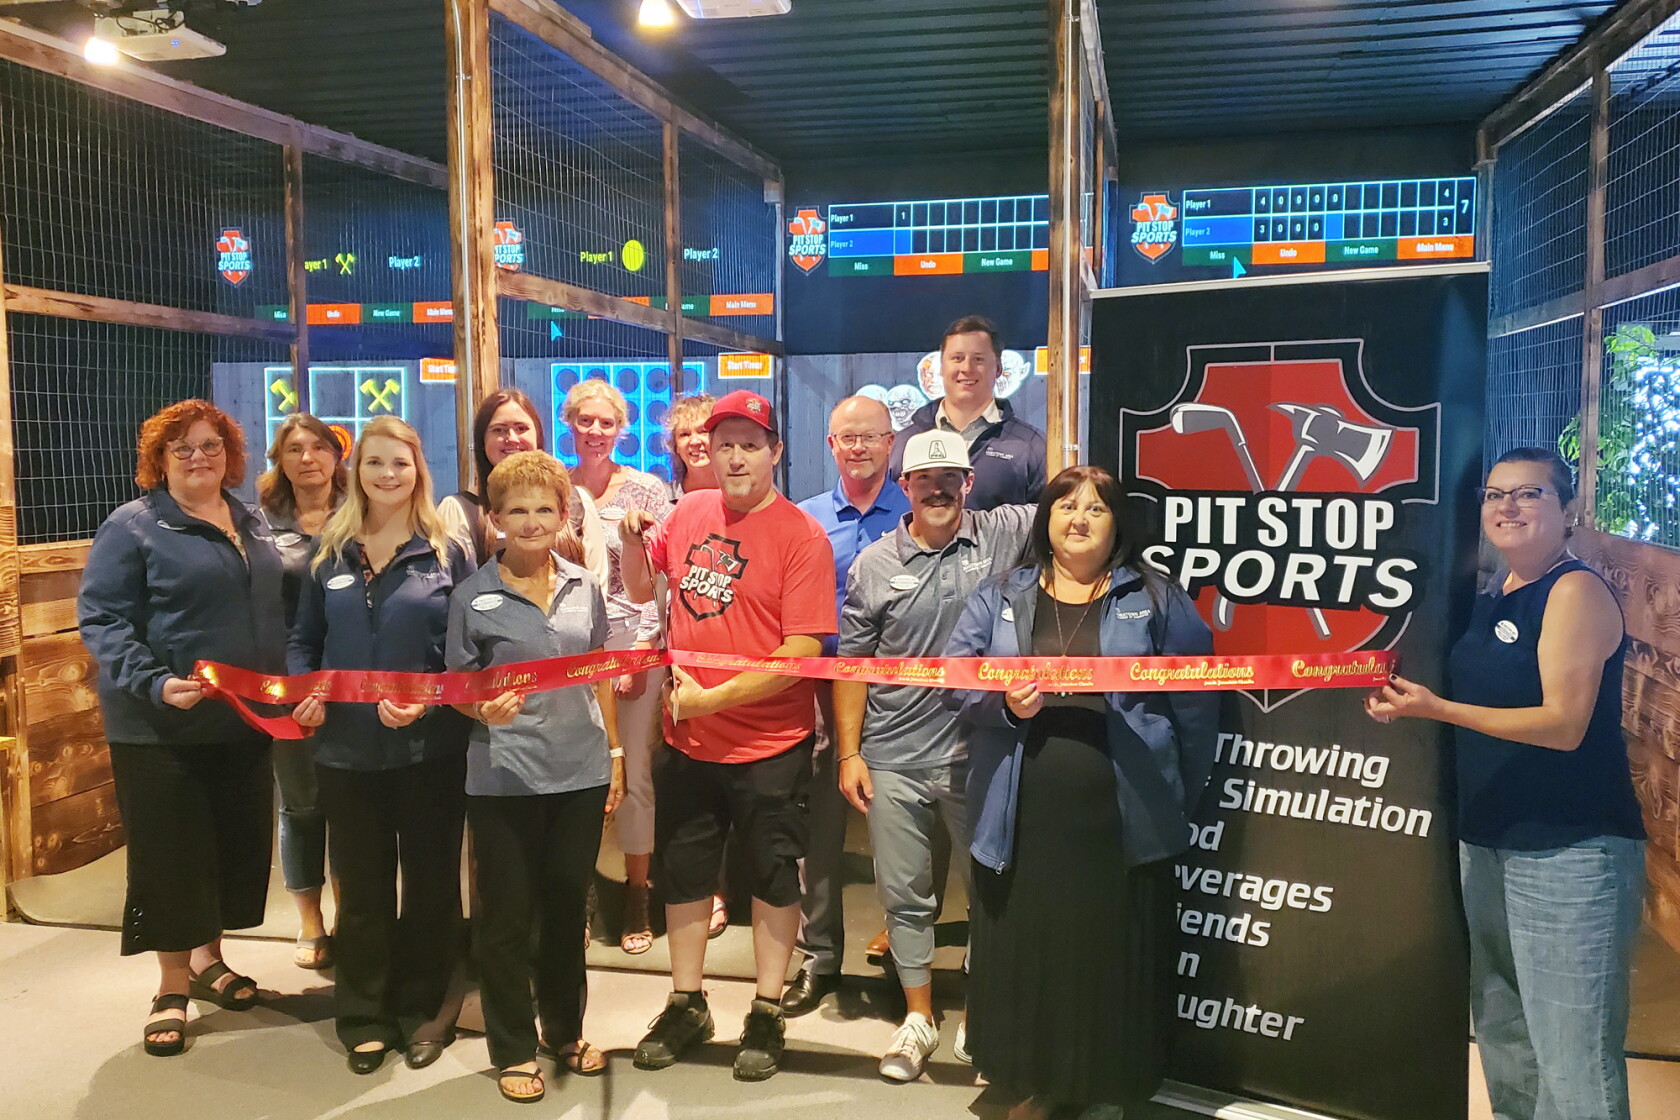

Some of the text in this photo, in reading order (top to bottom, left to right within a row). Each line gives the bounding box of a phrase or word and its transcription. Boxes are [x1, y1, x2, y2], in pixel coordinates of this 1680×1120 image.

[1185, 200, 1207, 210] Player
[1462, 201, 1468, 213] 7
[831, 213, 849, 223] Player
[1136, 220, 1174, 232] PIT STOP
[1131, 231, 1177, 243] SPORTS
[1185, 227, 1206, 238] Player
[793, 234, 823, 245] PIT STOP
[831, 240, 849, 249] Player
[503, 244, 520, 254] STOP
[789, 244, 826, 256] SPORTS
[1280, 248, 1298, 258] Undo
[1344, 245, 1379, 255] New Game
[1416, 242, 1454, 253] Main Menu
[220, 252, 248, 261] PIT STOP
[494, 254, 523, 264] PORTS
[580, 250, 613, 264] Player 1
[684, 248, 718, 262] Player 2
[1210, 251, 1225, 260] Miss
[218, 260, 250, 270] SPORTS
[304, 258, 327, 272] ayer 1
[388, 256, 420, 270] Player 2
[854, 262, 868, 270] Miss
[920, 260, 936, 268] Undo
[982, 257, 1012, 266] New Game
[1164, 496, 1394, 551] PIT STOP
[689, 565, 732, 588] PIT STOP
[1141, 545, 1418, 608] SPORTS
[680, 576, 734, 603] SPORTS
[834, 661, 945, 680] Congratulations
[978, 662, 1094, 686] Congratulations
[1130, 662, 1254, 686] Congratulations
[1214, 732, 1390, 788] Throwing
[1219, 778, 1432, 838] Simulation
[1175, 864, 1334, 912] verages
[1177, 993, 1304, 1041] ughter
